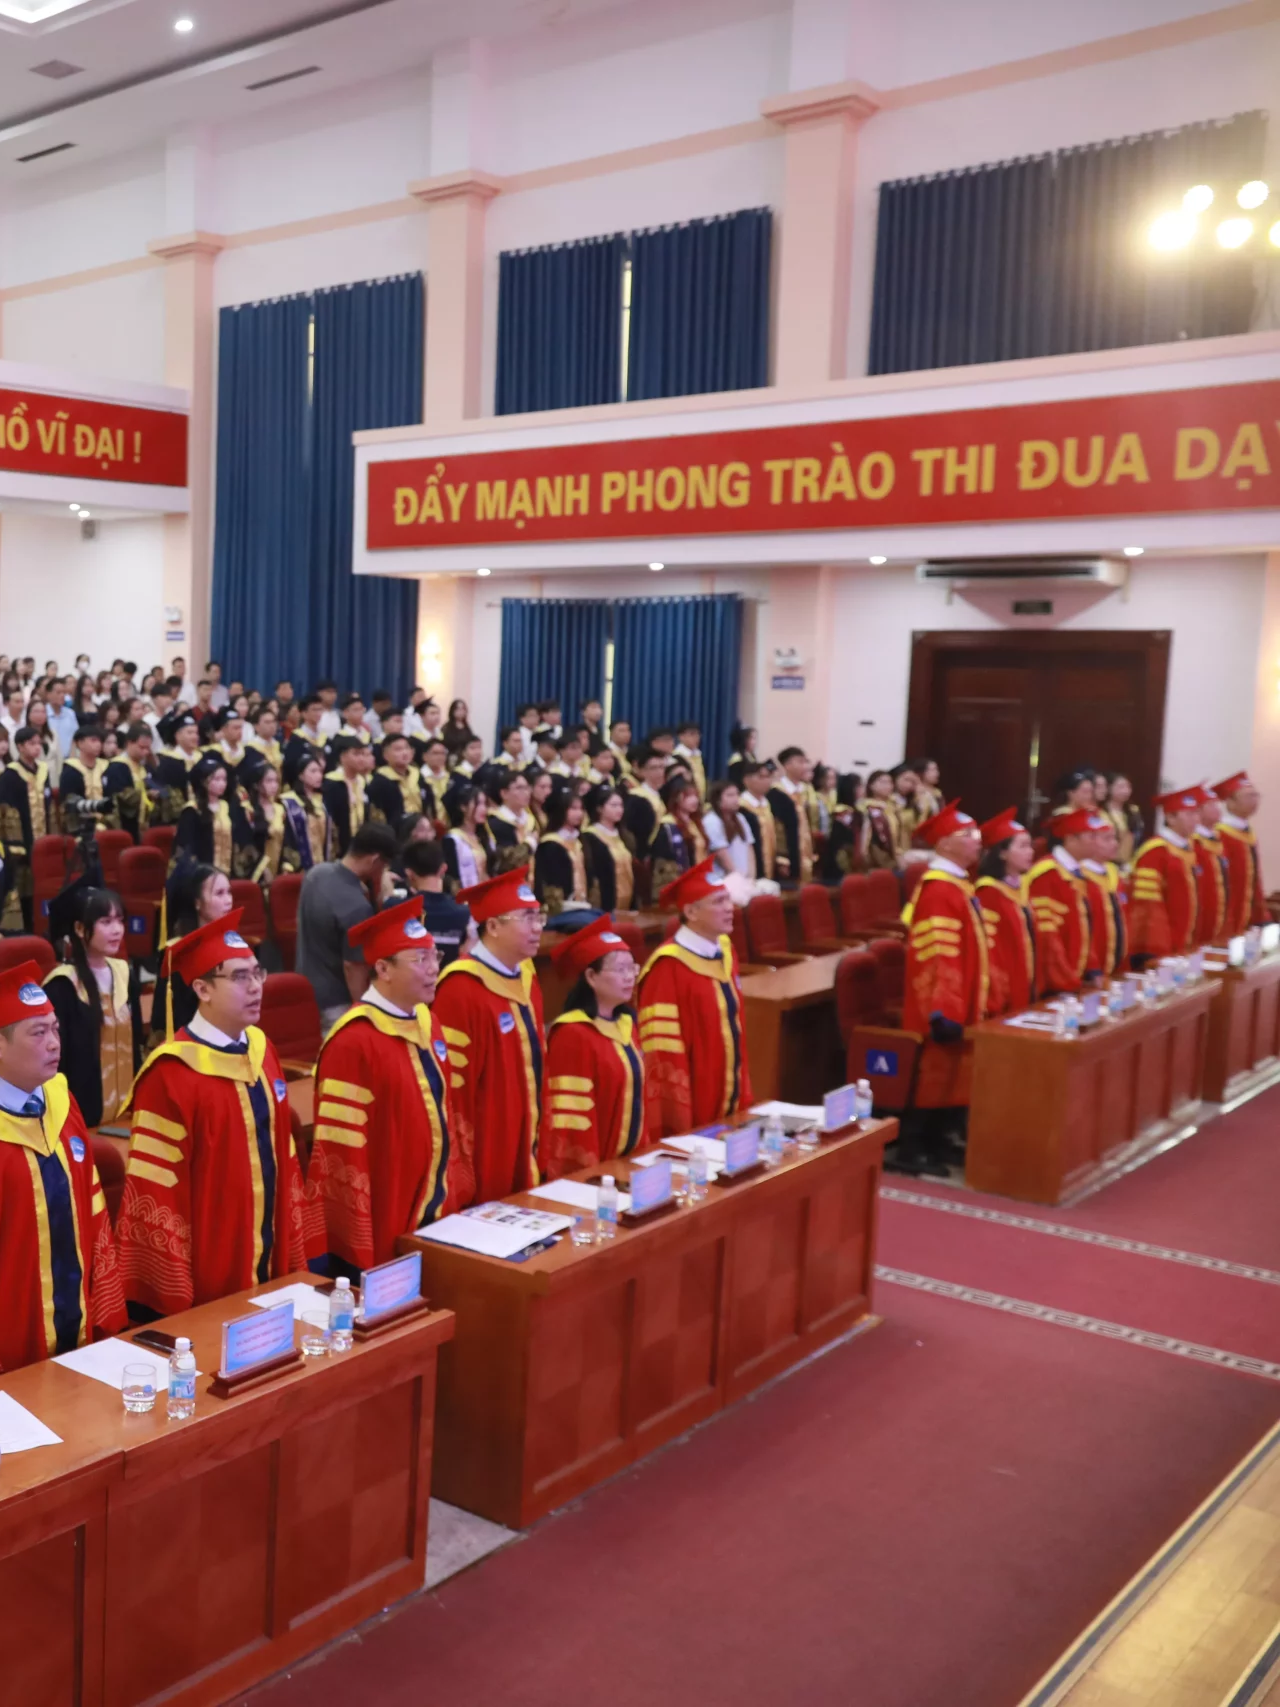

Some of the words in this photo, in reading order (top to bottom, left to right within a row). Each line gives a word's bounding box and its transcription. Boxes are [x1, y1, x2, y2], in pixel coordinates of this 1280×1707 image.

[37, 412, 69, 455] VĨ
[74, 428, 124, 469] ĐẠI
[134, 431, 141, 463] !
[394, 463, 469, 525] ĐẨY
[475, 474, 590, 528] MẠNH
[601, 462, 750, 514] PHONG
[763, 442, 895, 504] TRÀO
[911, 444, 996, 497] THI
[1017, 431, 1150, 491] ĐUA
[1173, 420, 1280, 491] DẠ
[873, 1055, 889, 1073] A
